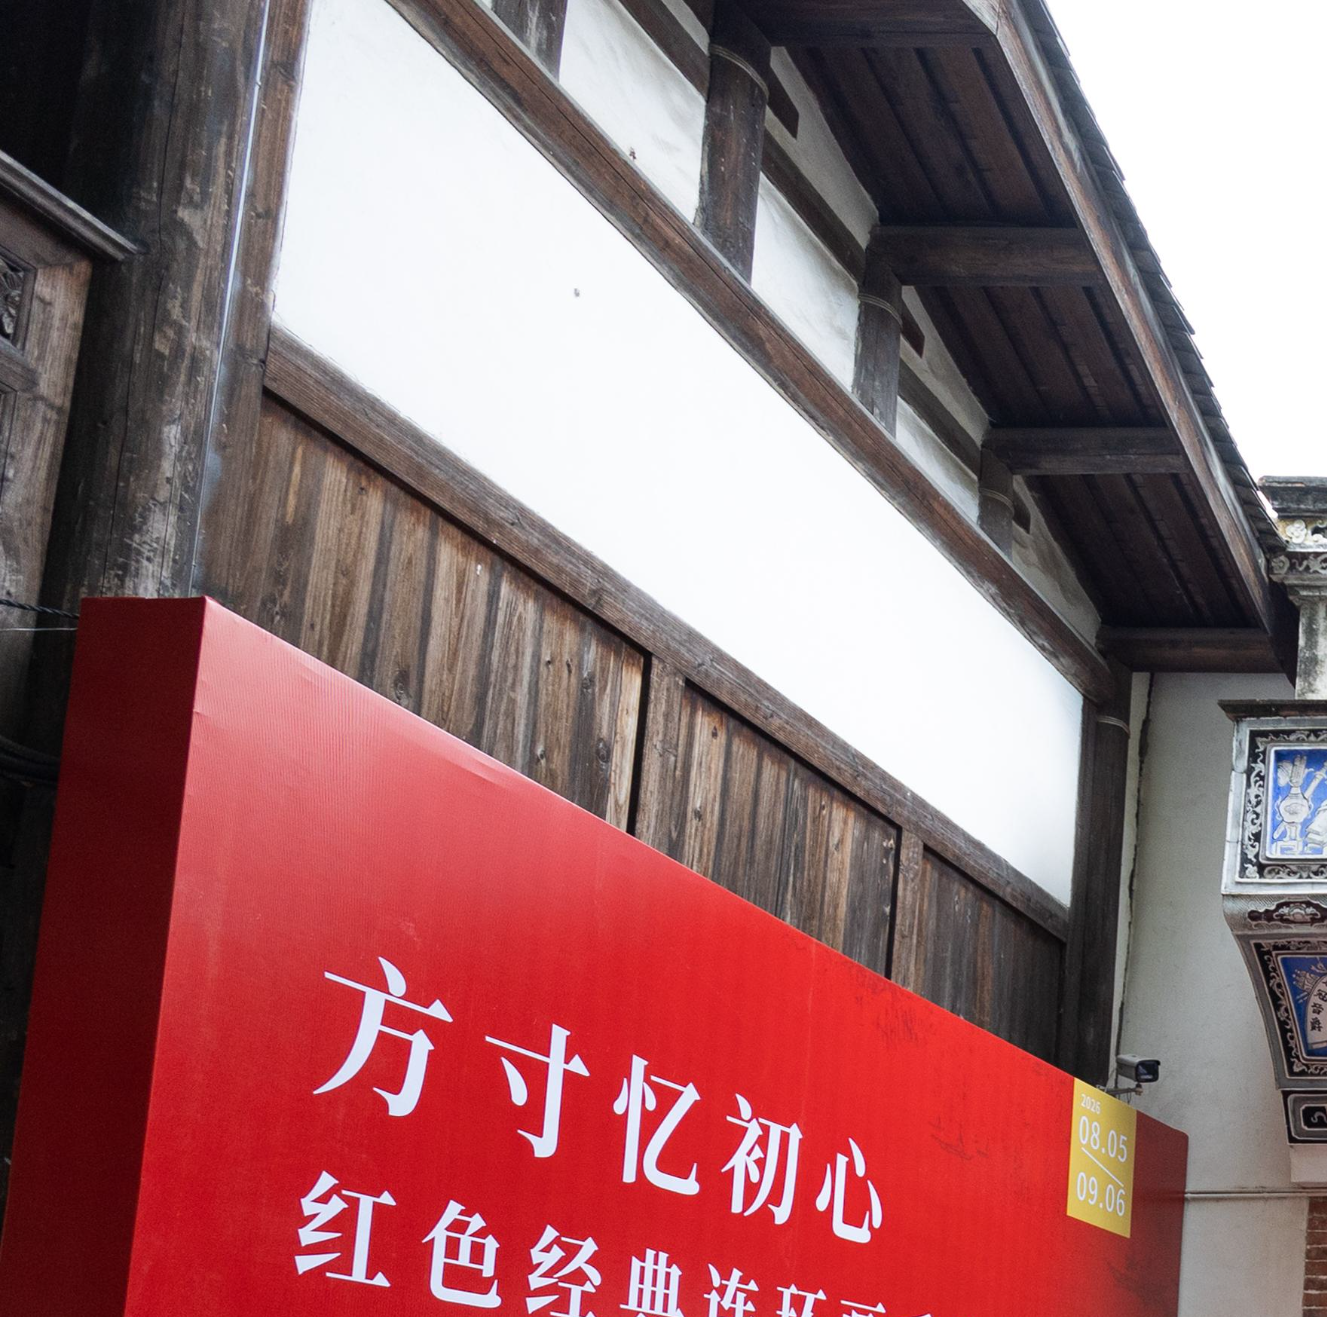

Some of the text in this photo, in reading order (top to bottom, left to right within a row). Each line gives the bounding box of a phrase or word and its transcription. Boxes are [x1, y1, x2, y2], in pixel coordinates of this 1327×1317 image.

[312, 956, 883, 1244] 方寸忆初心
[1079, 1115, 1128, 1163] 08.05
[1077, 1171, 1126, 1217] 09.06
